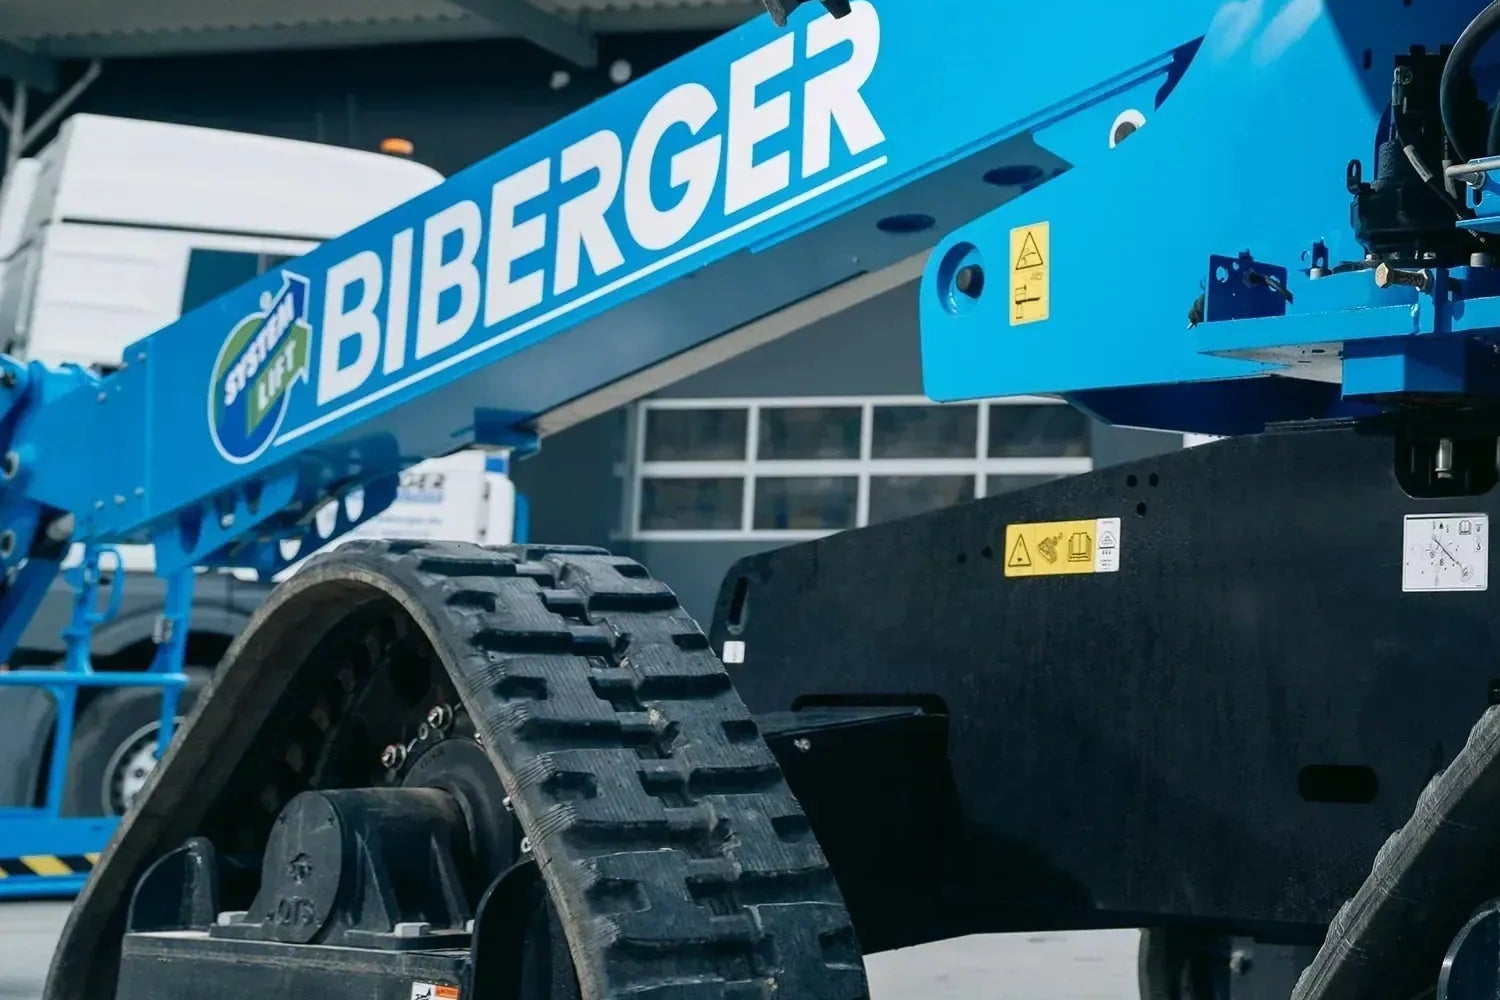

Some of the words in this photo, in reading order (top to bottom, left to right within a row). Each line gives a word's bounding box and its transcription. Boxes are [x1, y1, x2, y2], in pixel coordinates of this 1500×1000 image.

[317, 0, 886, 406] BIBERGER
[224, 291, 294, 407] SYSTEM
[257, 339, 296, 411] LIFT
